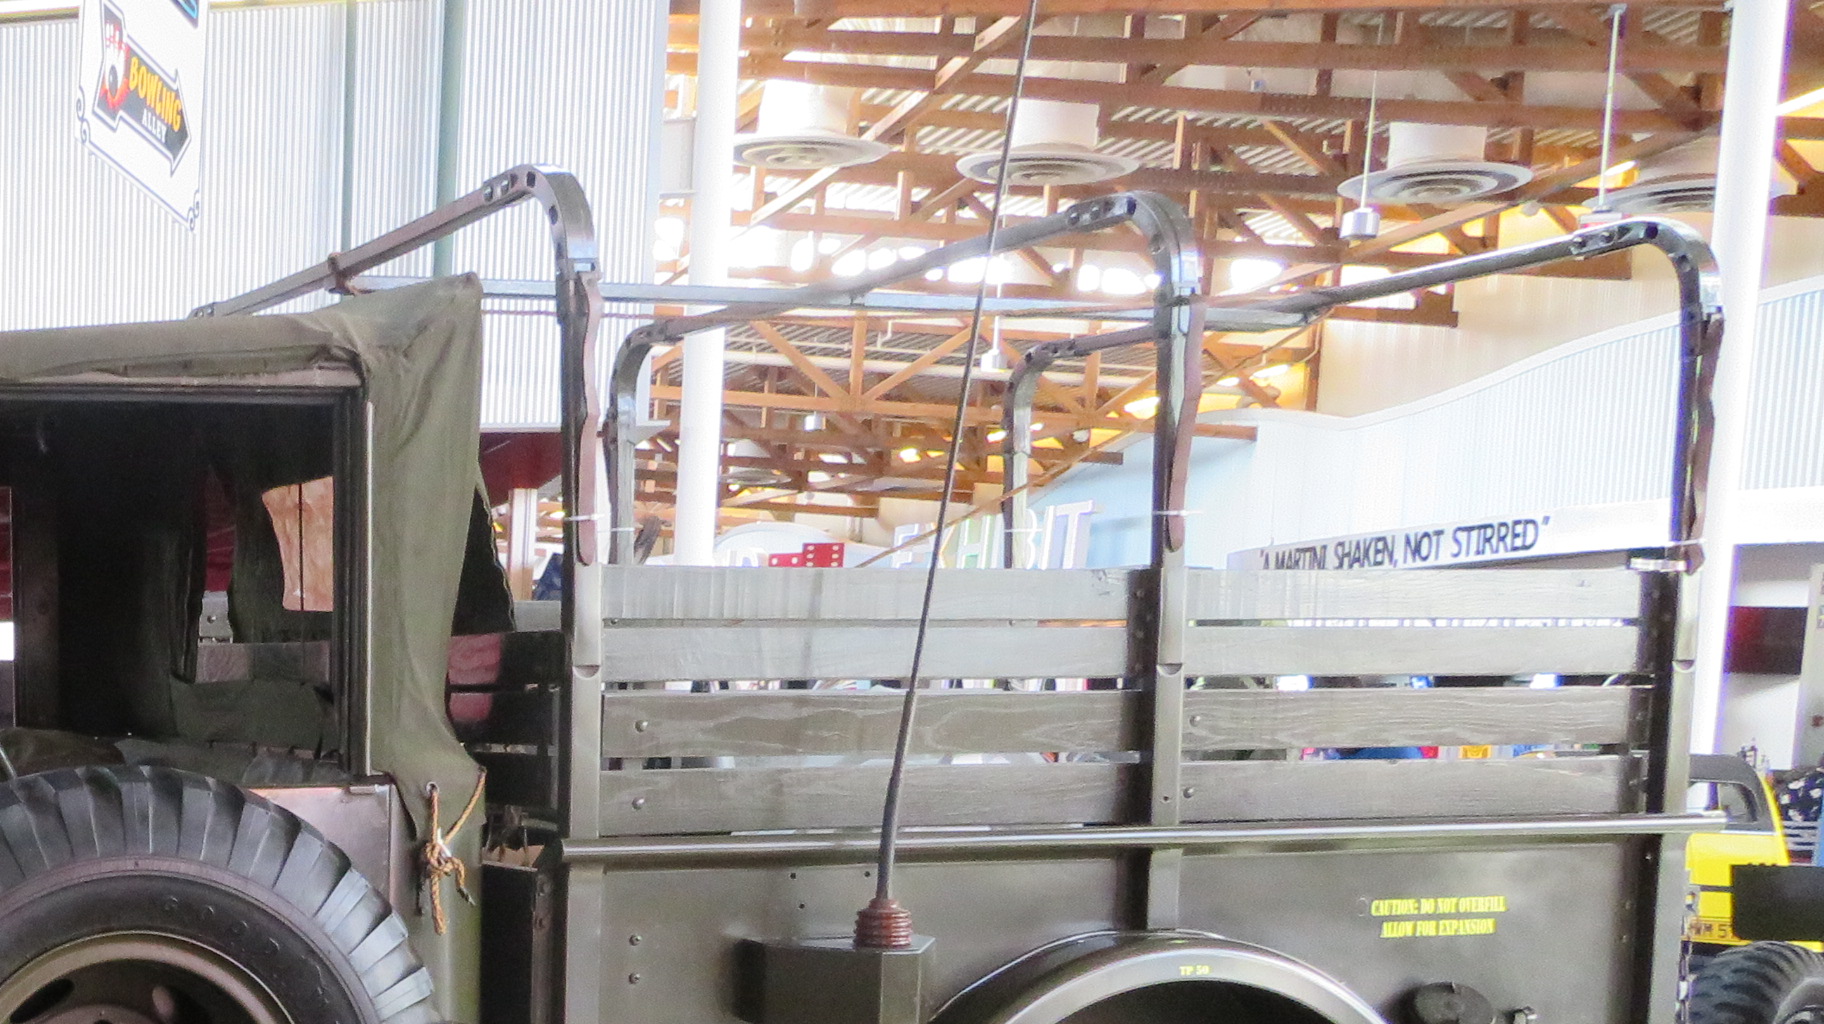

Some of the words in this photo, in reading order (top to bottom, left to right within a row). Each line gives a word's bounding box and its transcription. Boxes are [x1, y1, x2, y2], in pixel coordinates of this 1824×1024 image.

[129, 56, 182, 132] BOWLING
[141, 108, 167, 143] ALLEY
[1333, 535, 1398, 569] SHAKEN,
[1403, 529, 1444, 565] NOT
[1451, 515, 1550, 559] STIRRED"
[1370, 898, 1419, 917] CAUTION:
[1420, 898, 1435, 914] DO
[1436, 897, 1458, 914] NOT
[1459, 895, 1508, 913] OVERFILL
[1380, 920, 1415, 938] ALLOW
[1415, 919, 1438, 937] FOR
[1438, 917, 1496, 936] EXPANSION
[1179, 965, 1194, 976] TP
[1196, 964, 1210, 976] 50
